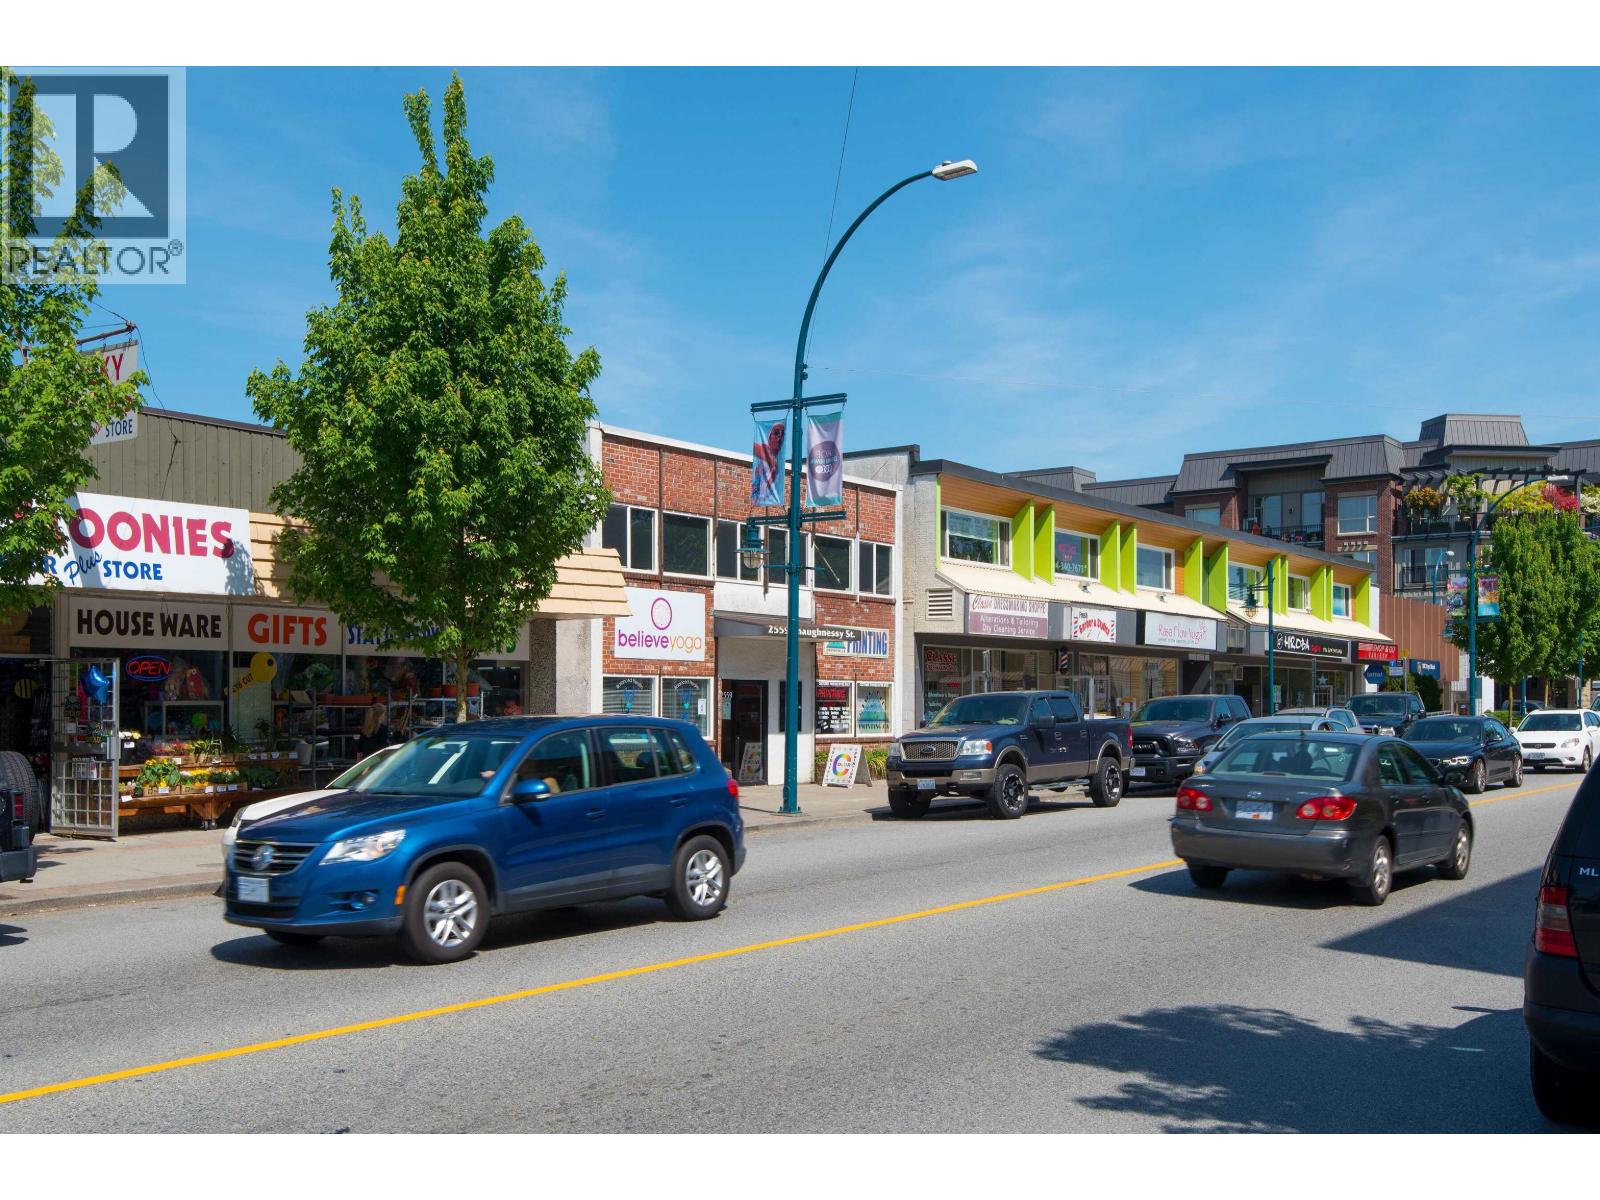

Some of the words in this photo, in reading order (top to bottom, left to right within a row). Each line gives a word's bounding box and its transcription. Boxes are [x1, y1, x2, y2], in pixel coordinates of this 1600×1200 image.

[105, 419, 133, 438] STORE
[67, 506, 235, 560] OONIES
[103, 559, 163, 581] STORE
[77, 608, 154, 637] HOUSE
[160, 612, 222, 639] WARE
[247, 613, 327, 647] GIFTS
[799, 628, 844, 638] aughnessy
[845, 629, 856, 638] St.
[127, 660, 171, 676] OPEN
